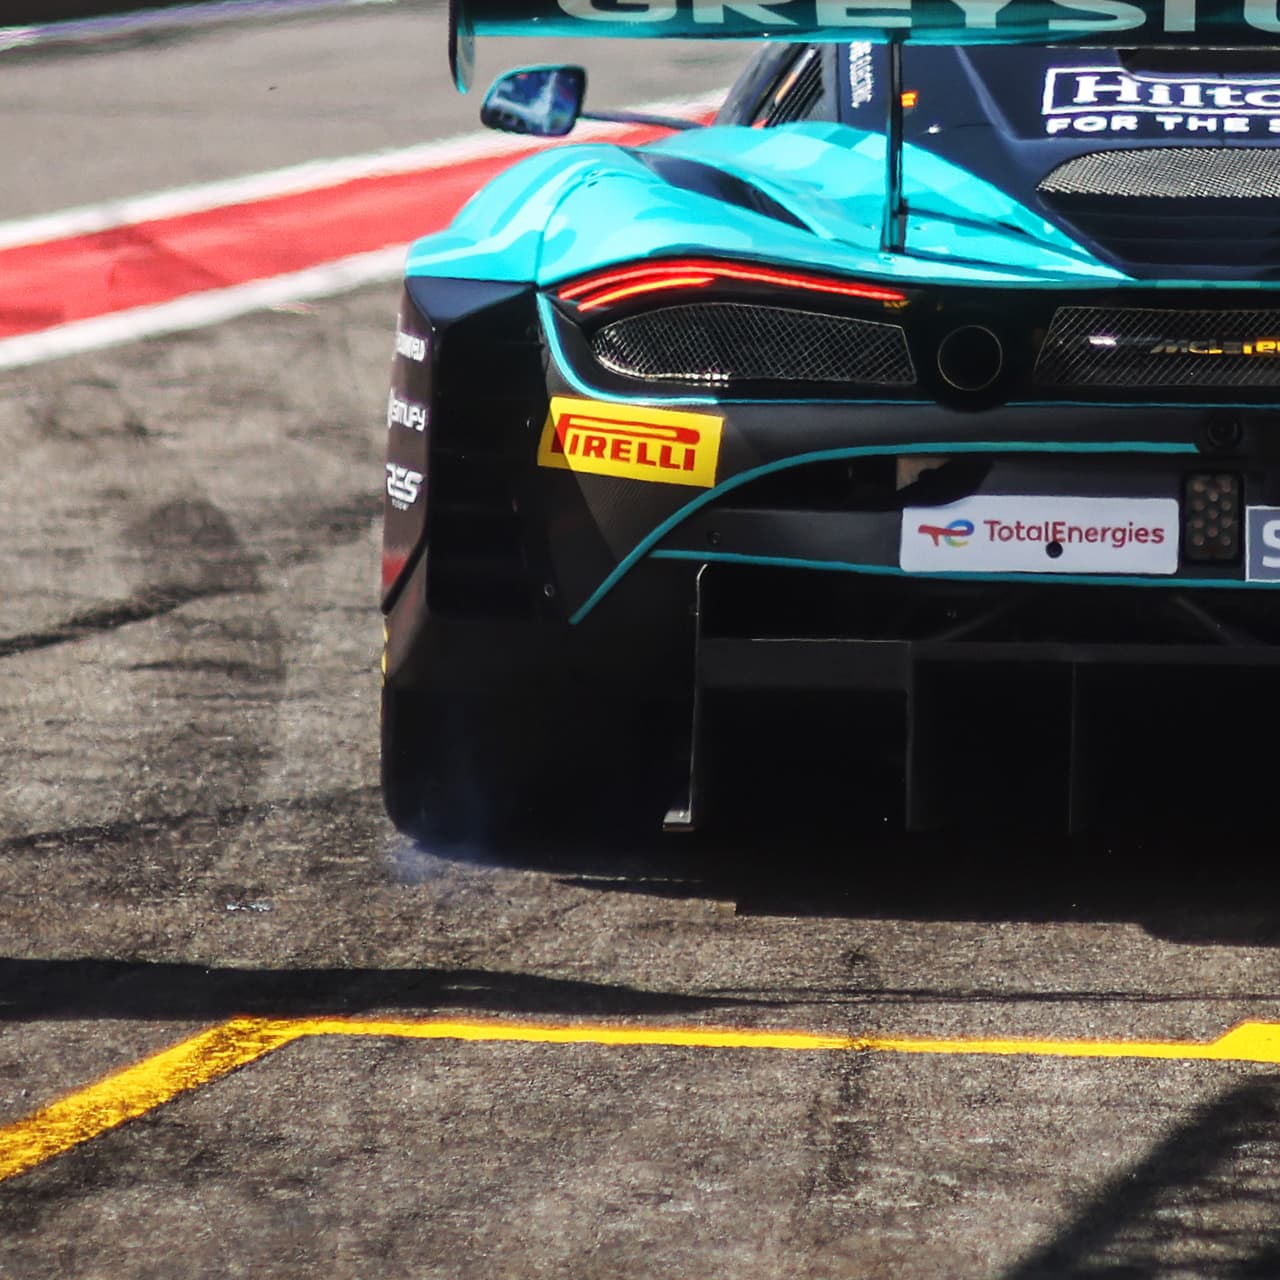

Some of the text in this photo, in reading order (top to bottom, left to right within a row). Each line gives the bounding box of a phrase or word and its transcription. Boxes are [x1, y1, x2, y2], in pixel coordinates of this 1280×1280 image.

[1046, 115, 1138, 134] FOR
[1156, 114, 1250, 132] THE
[551, 414, 701, 471] PIRELLI
[983, 520, 1165, 548] TotalEnergies
